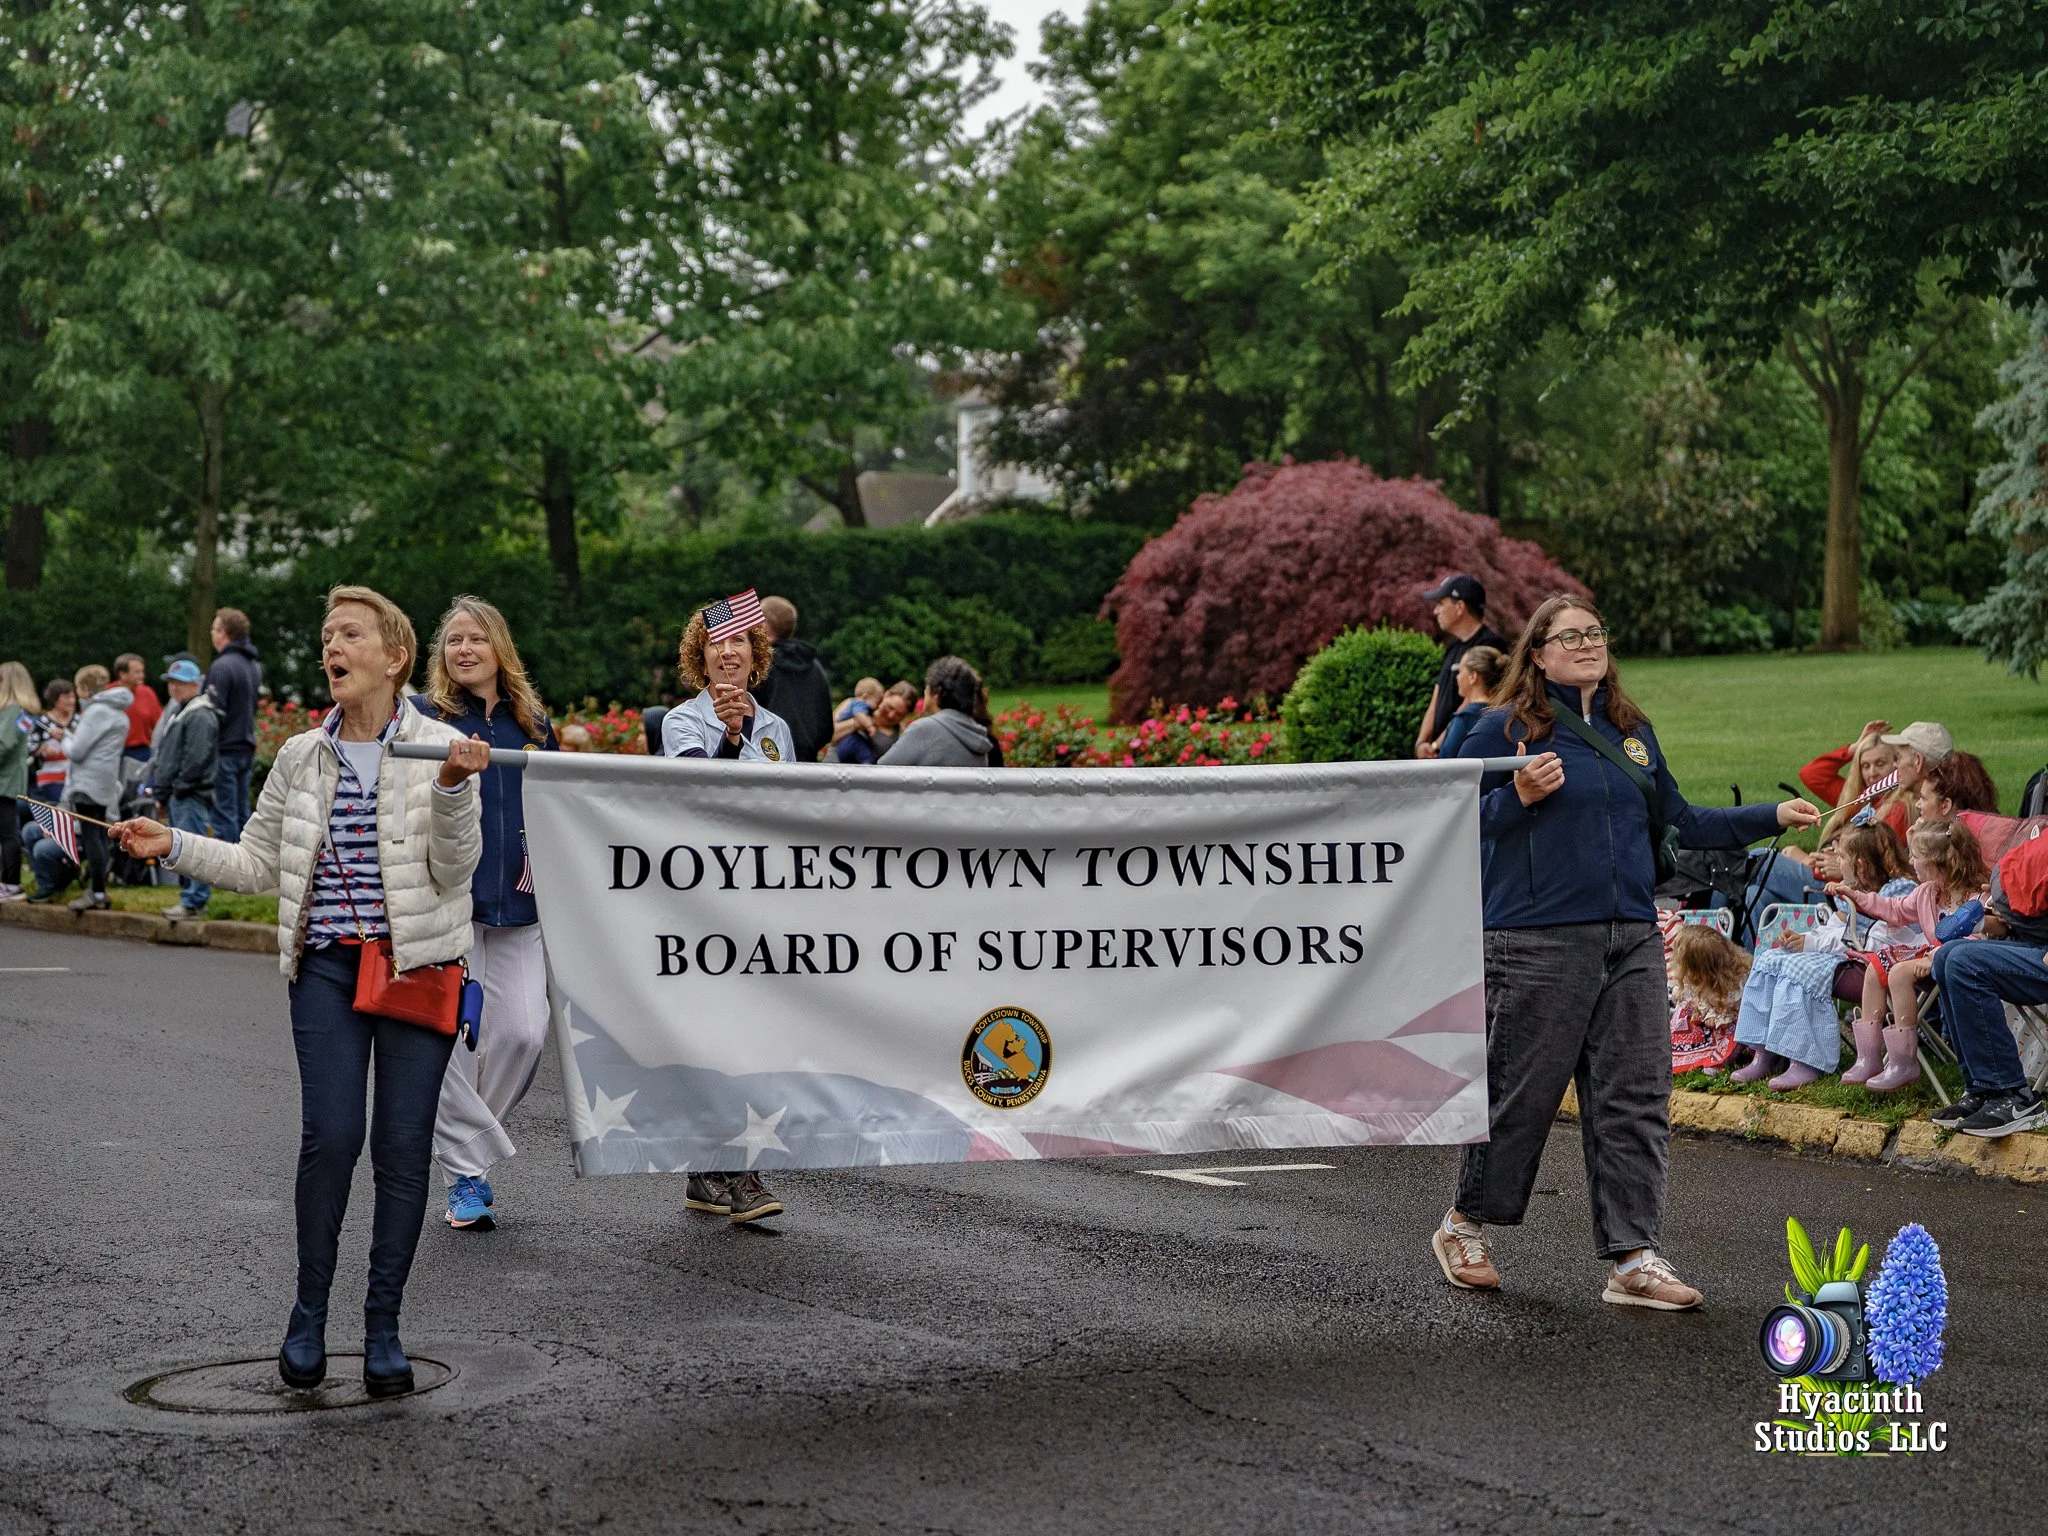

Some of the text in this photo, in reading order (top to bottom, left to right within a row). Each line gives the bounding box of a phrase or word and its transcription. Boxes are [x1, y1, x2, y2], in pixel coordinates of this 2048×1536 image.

[608, 841, 1406, 891] DOYLESTOWN TOWNSHIP
[655, 924, 1365, 976] BOARD OF SUPERVISORS
[974, 1009, 1049, 1044] DOYLESTOWN TOWNSHIP
[963, 1059, 975, 1087] BUCKS
[1006, 1069, 1048, 1107] PENNSYLVANIA
